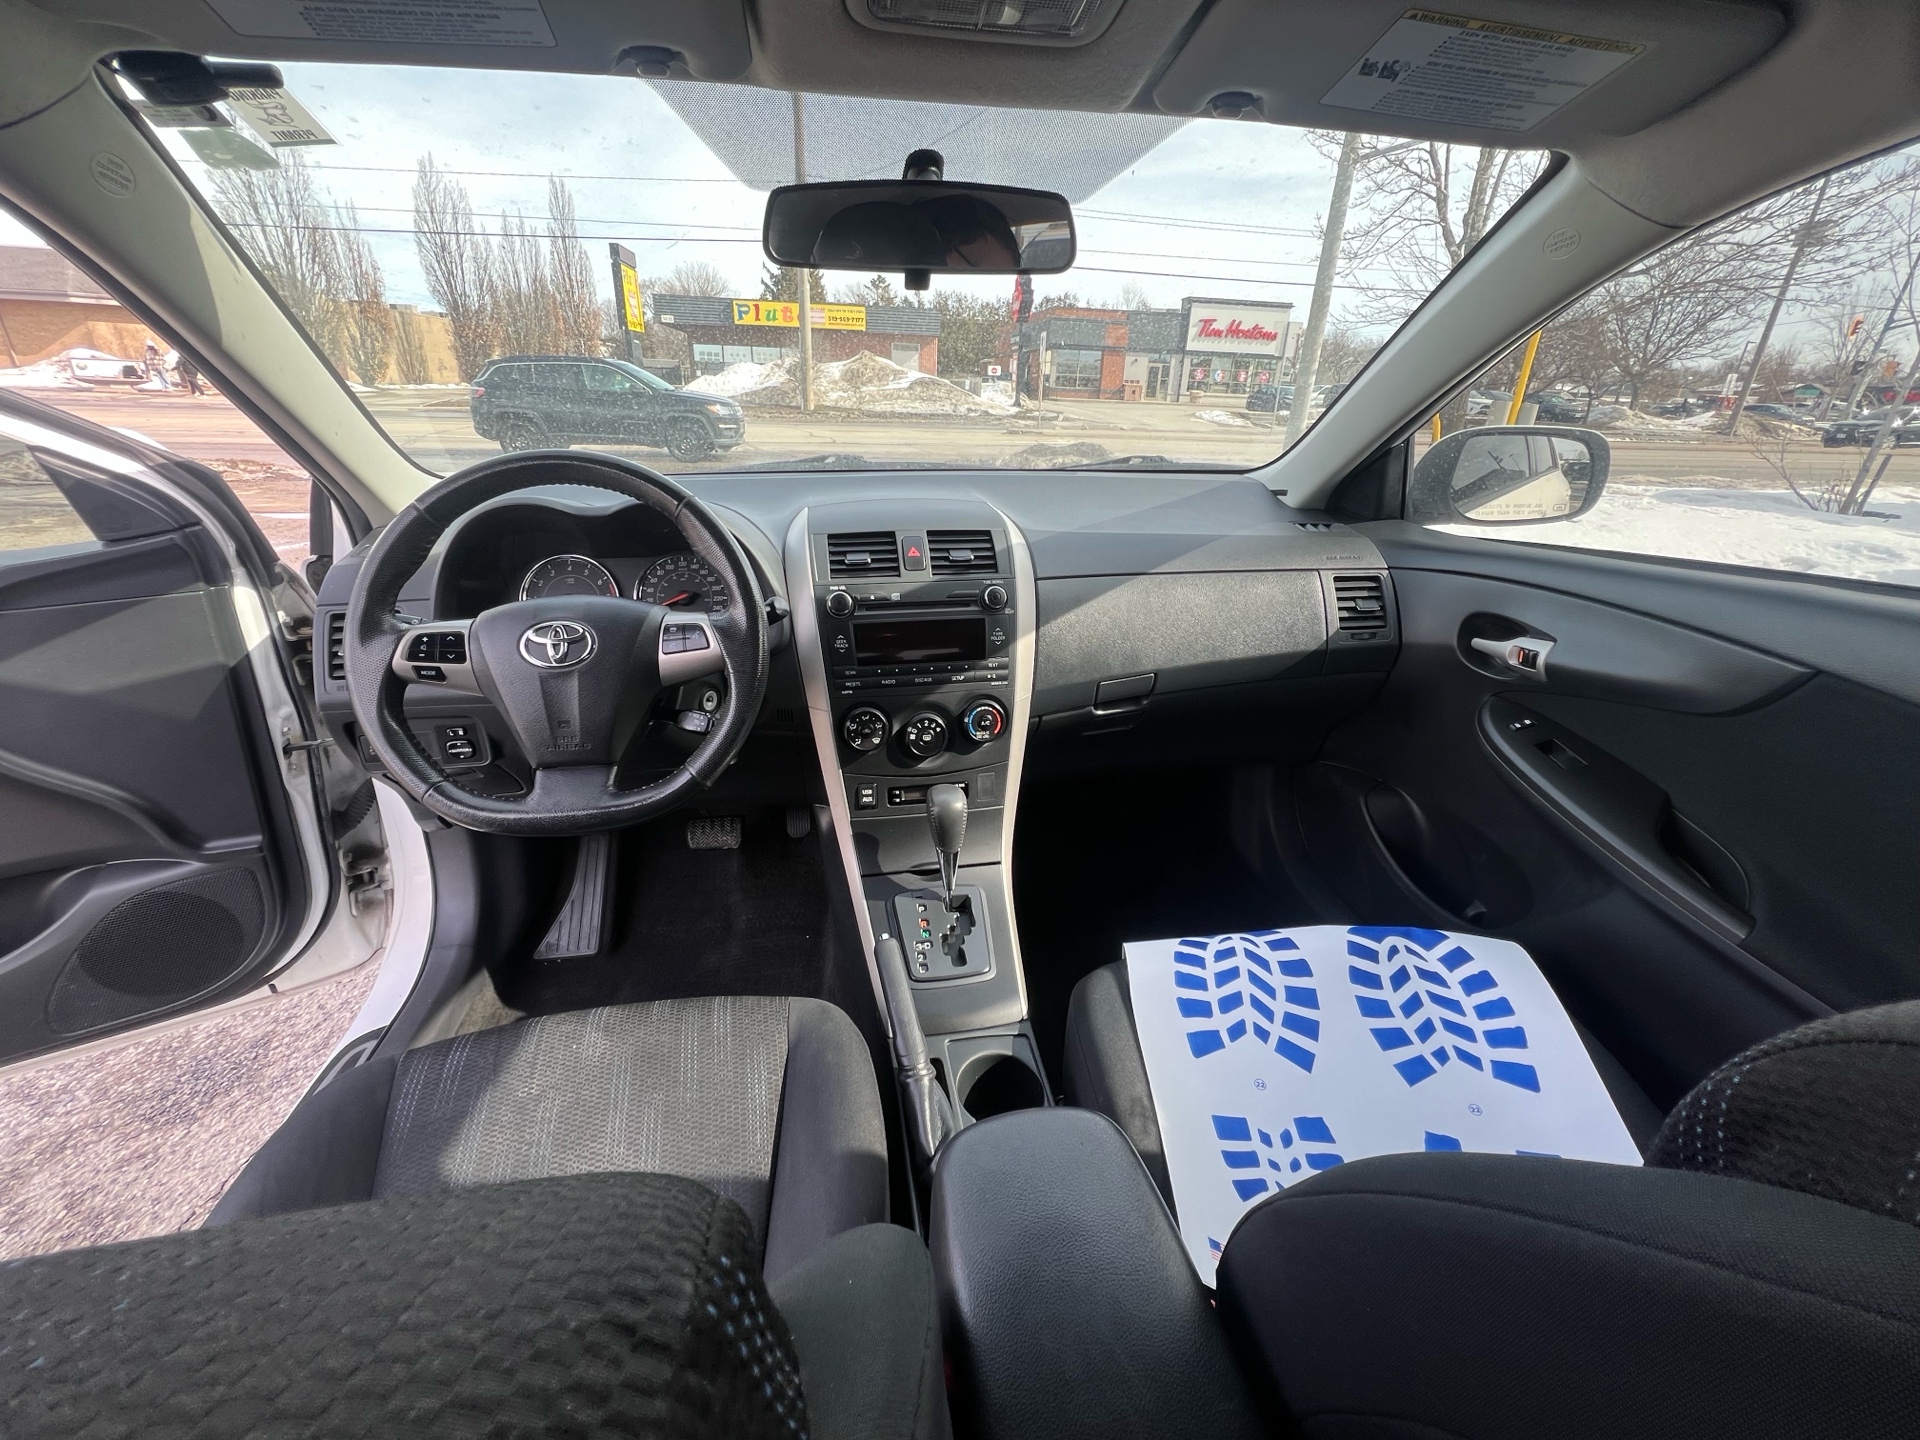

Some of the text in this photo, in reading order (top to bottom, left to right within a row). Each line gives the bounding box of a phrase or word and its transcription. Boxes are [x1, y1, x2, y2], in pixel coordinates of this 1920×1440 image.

[1418, 13, 1469, 28] WARNING
[1478, 23, 1567, 42] AVERTISSEMENT
[735, 302, 800, 323] Plut
[1198, 318, 1279, 341] Tim Hortons
[918, 905, 925, 913] P
[916, 942, 931, 951] 3-D
[917, 954, 924, 962] 2
[919, 965, 925, 973] L
